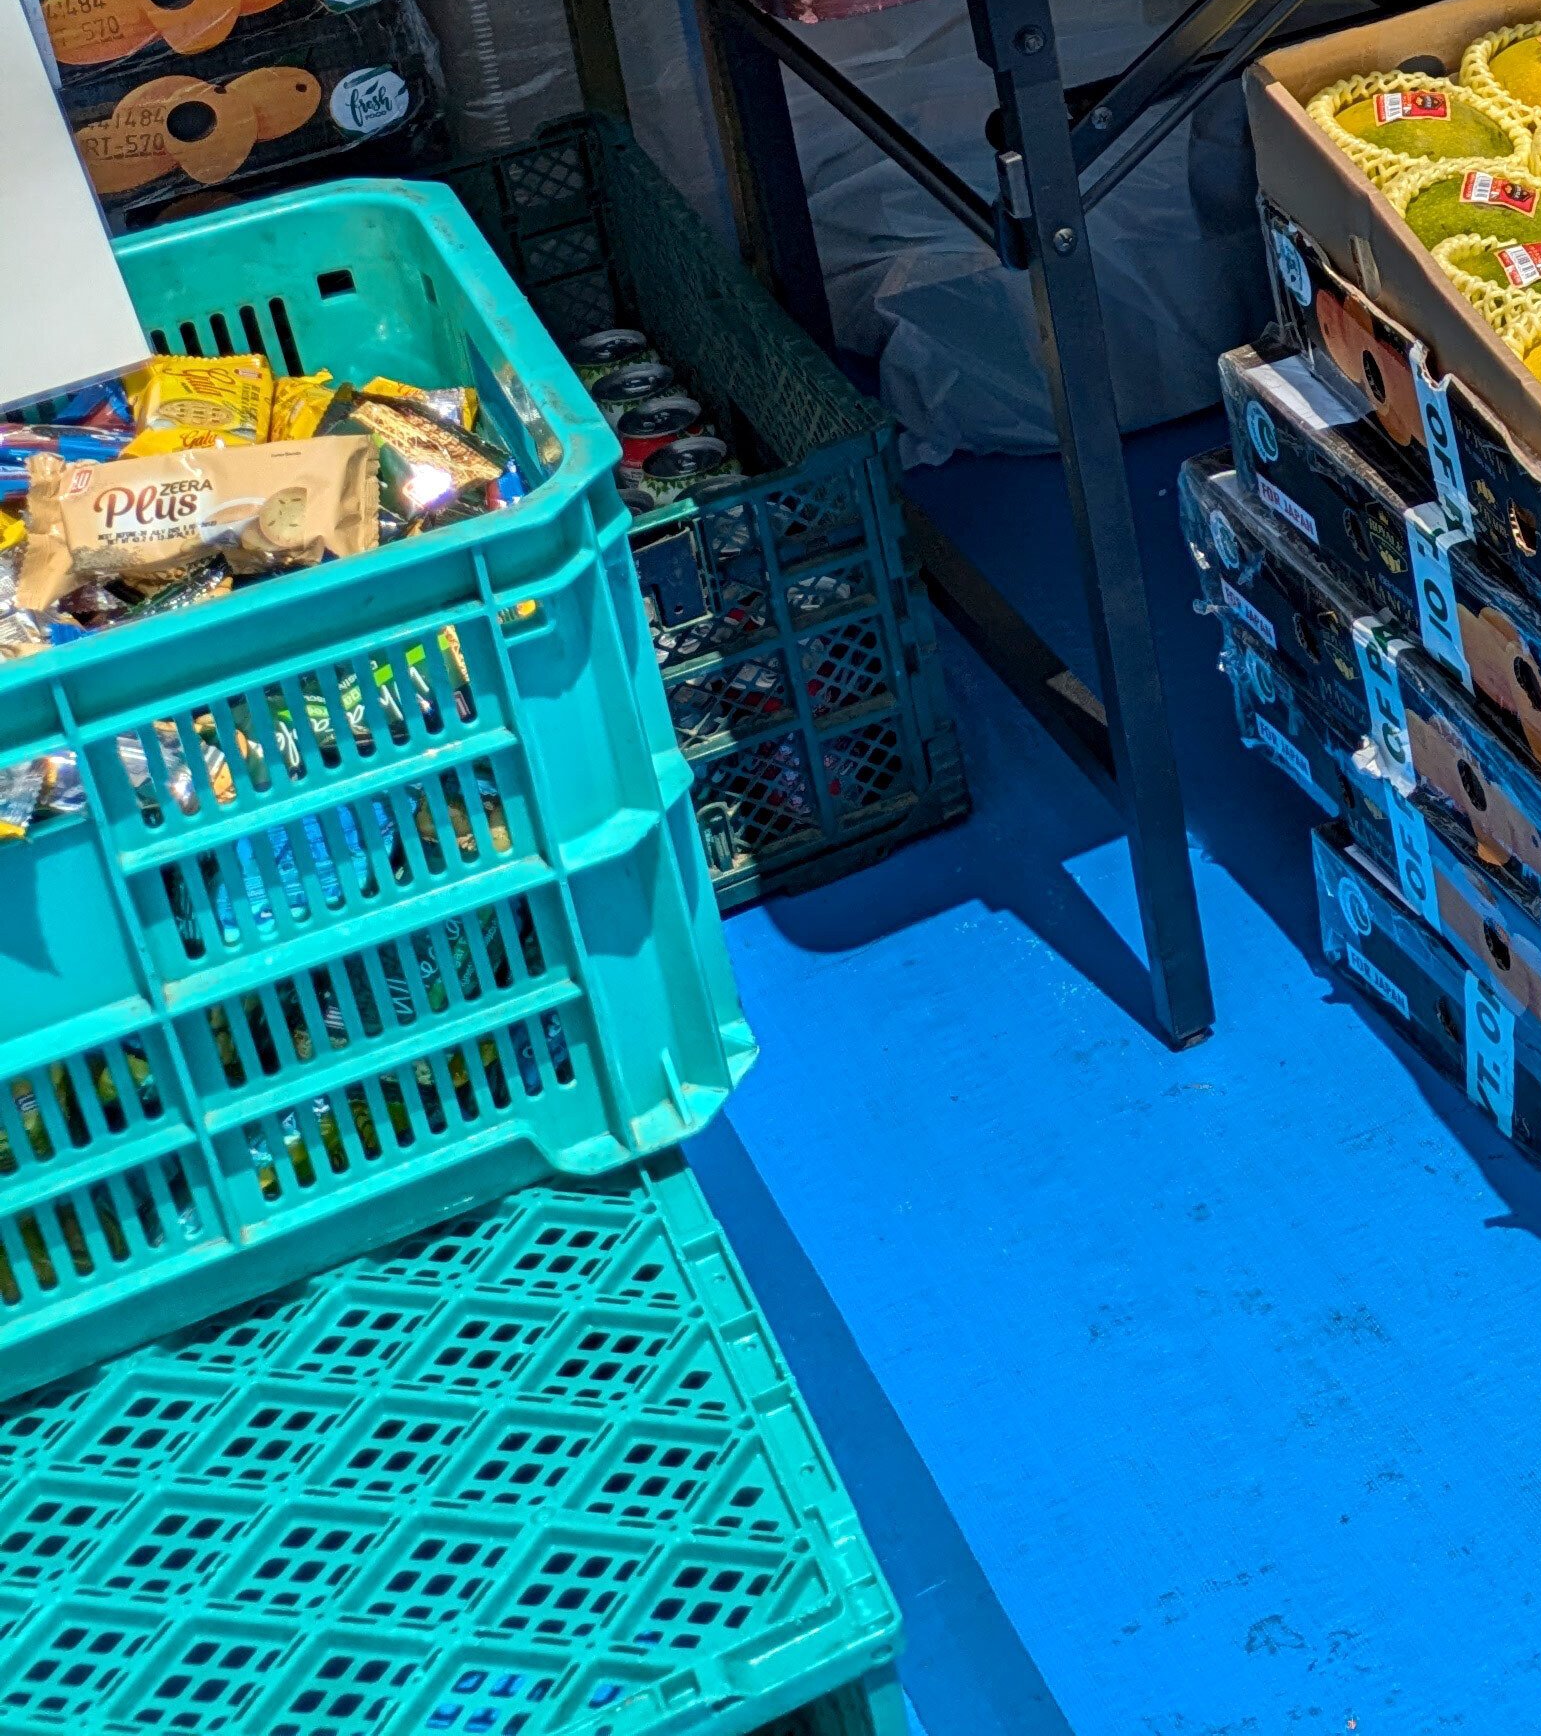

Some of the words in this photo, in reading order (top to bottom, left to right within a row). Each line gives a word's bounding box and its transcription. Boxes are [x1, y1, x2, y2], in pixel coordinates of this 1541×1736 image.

[347, 93, 391, 129] fresh
[160, 478, 213, 497] ZEERA
[93, 484, 198, 529] Plus
